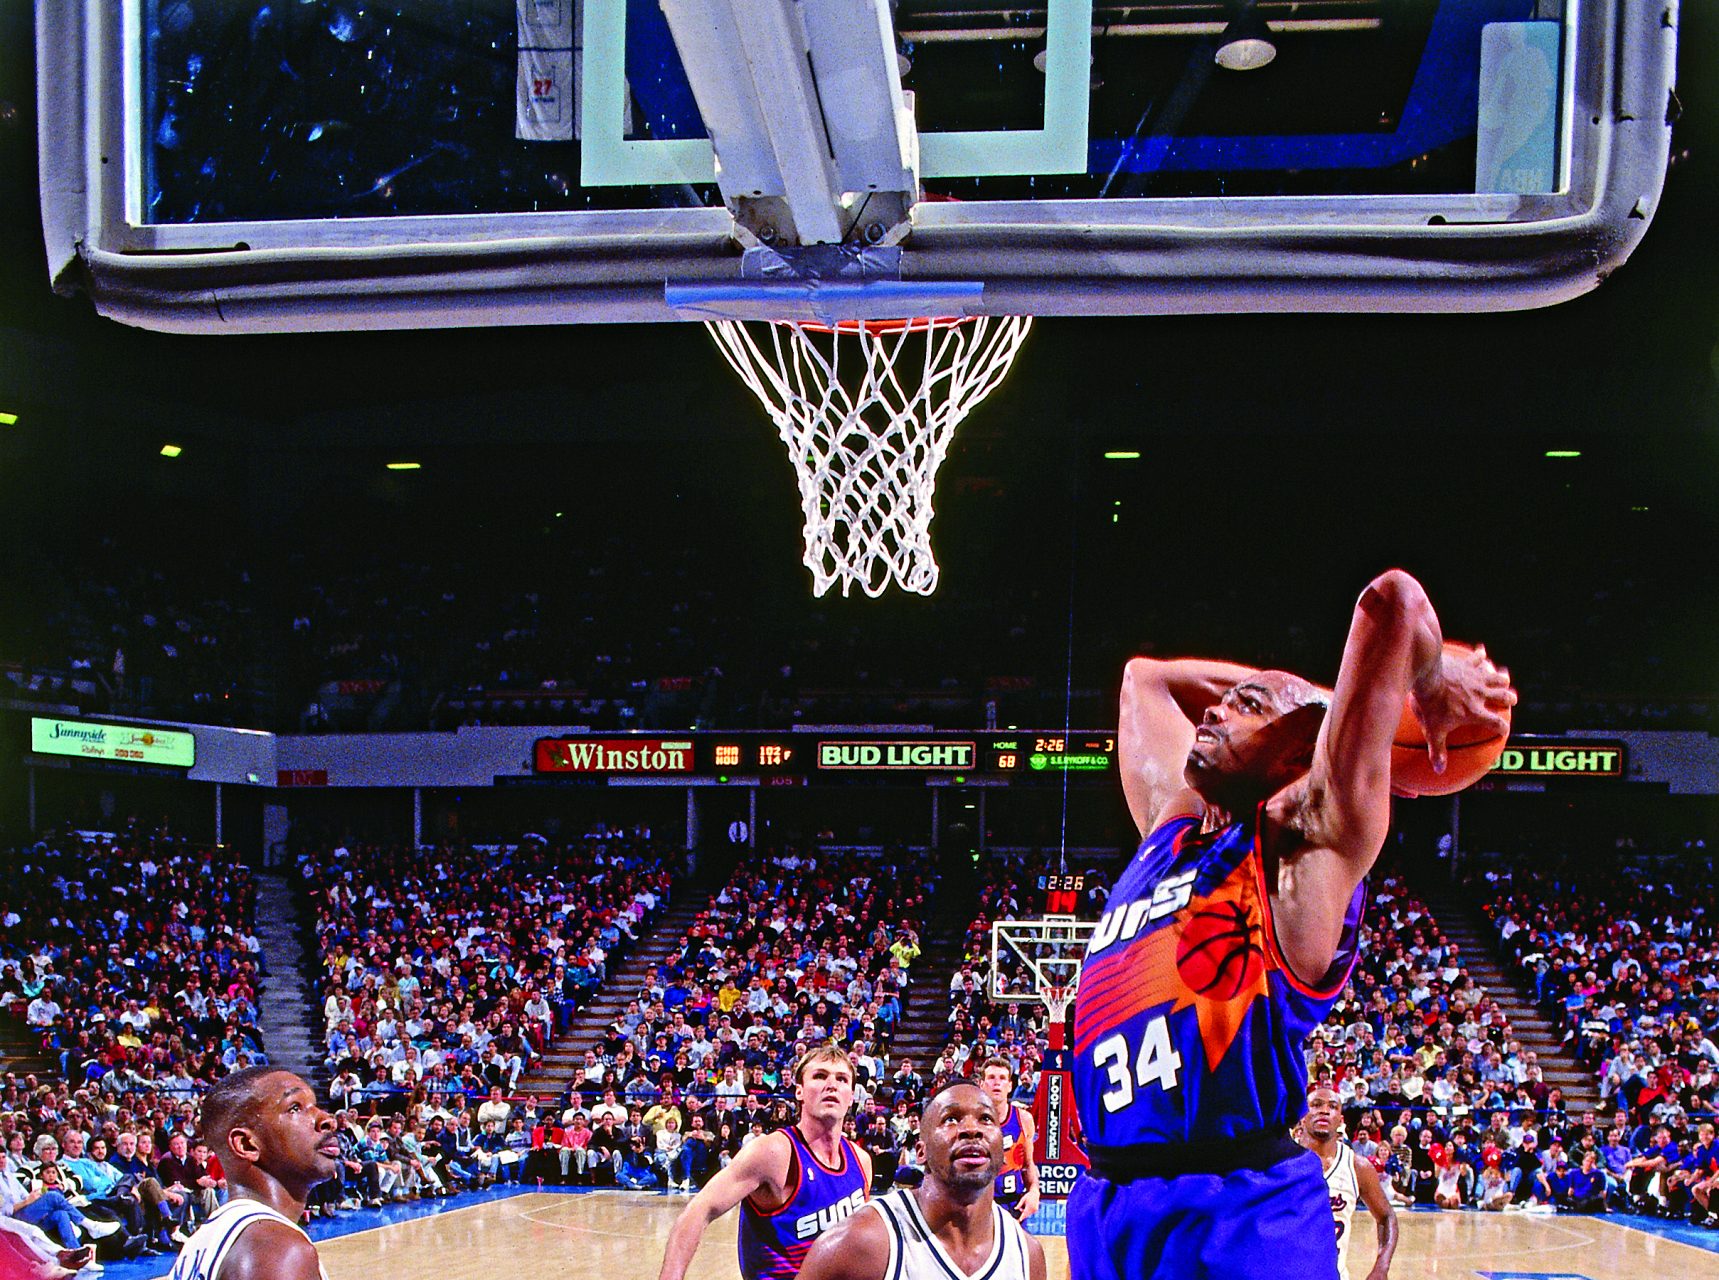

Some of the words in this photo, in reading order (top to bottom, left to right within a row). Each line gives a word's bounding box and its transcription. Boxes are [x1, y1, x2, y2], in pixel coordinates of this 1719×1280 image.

[533, 79, 553, 96] 27
[49, 722, 107, 741] Sunnyside
[993, 741, 1018, 750] HOME
[1035, 739, 1065, 752] 2:26
[1104, 739, 1114, 752] 3
[567, 743, 685, 770] Winston
[822, 746, 881, 765] BUD
[887, 746, 971, 766] LIGHT
[998, 755, 1016, 768] 68
[1530, 750, 1617, 771] LIGHT
[1048, 876, 1084, 890] 2:26
[1049, 890, 1077, 913] 14
[1084, 868, 1198, 960] UNS
[1093, 1014, 1182, 1114] 34
[1051, 1075, 1059, 1109] FOOT
[1004, 1175, 1016, 1194] 9
[796, 1188, 866, 1239] SUNS
